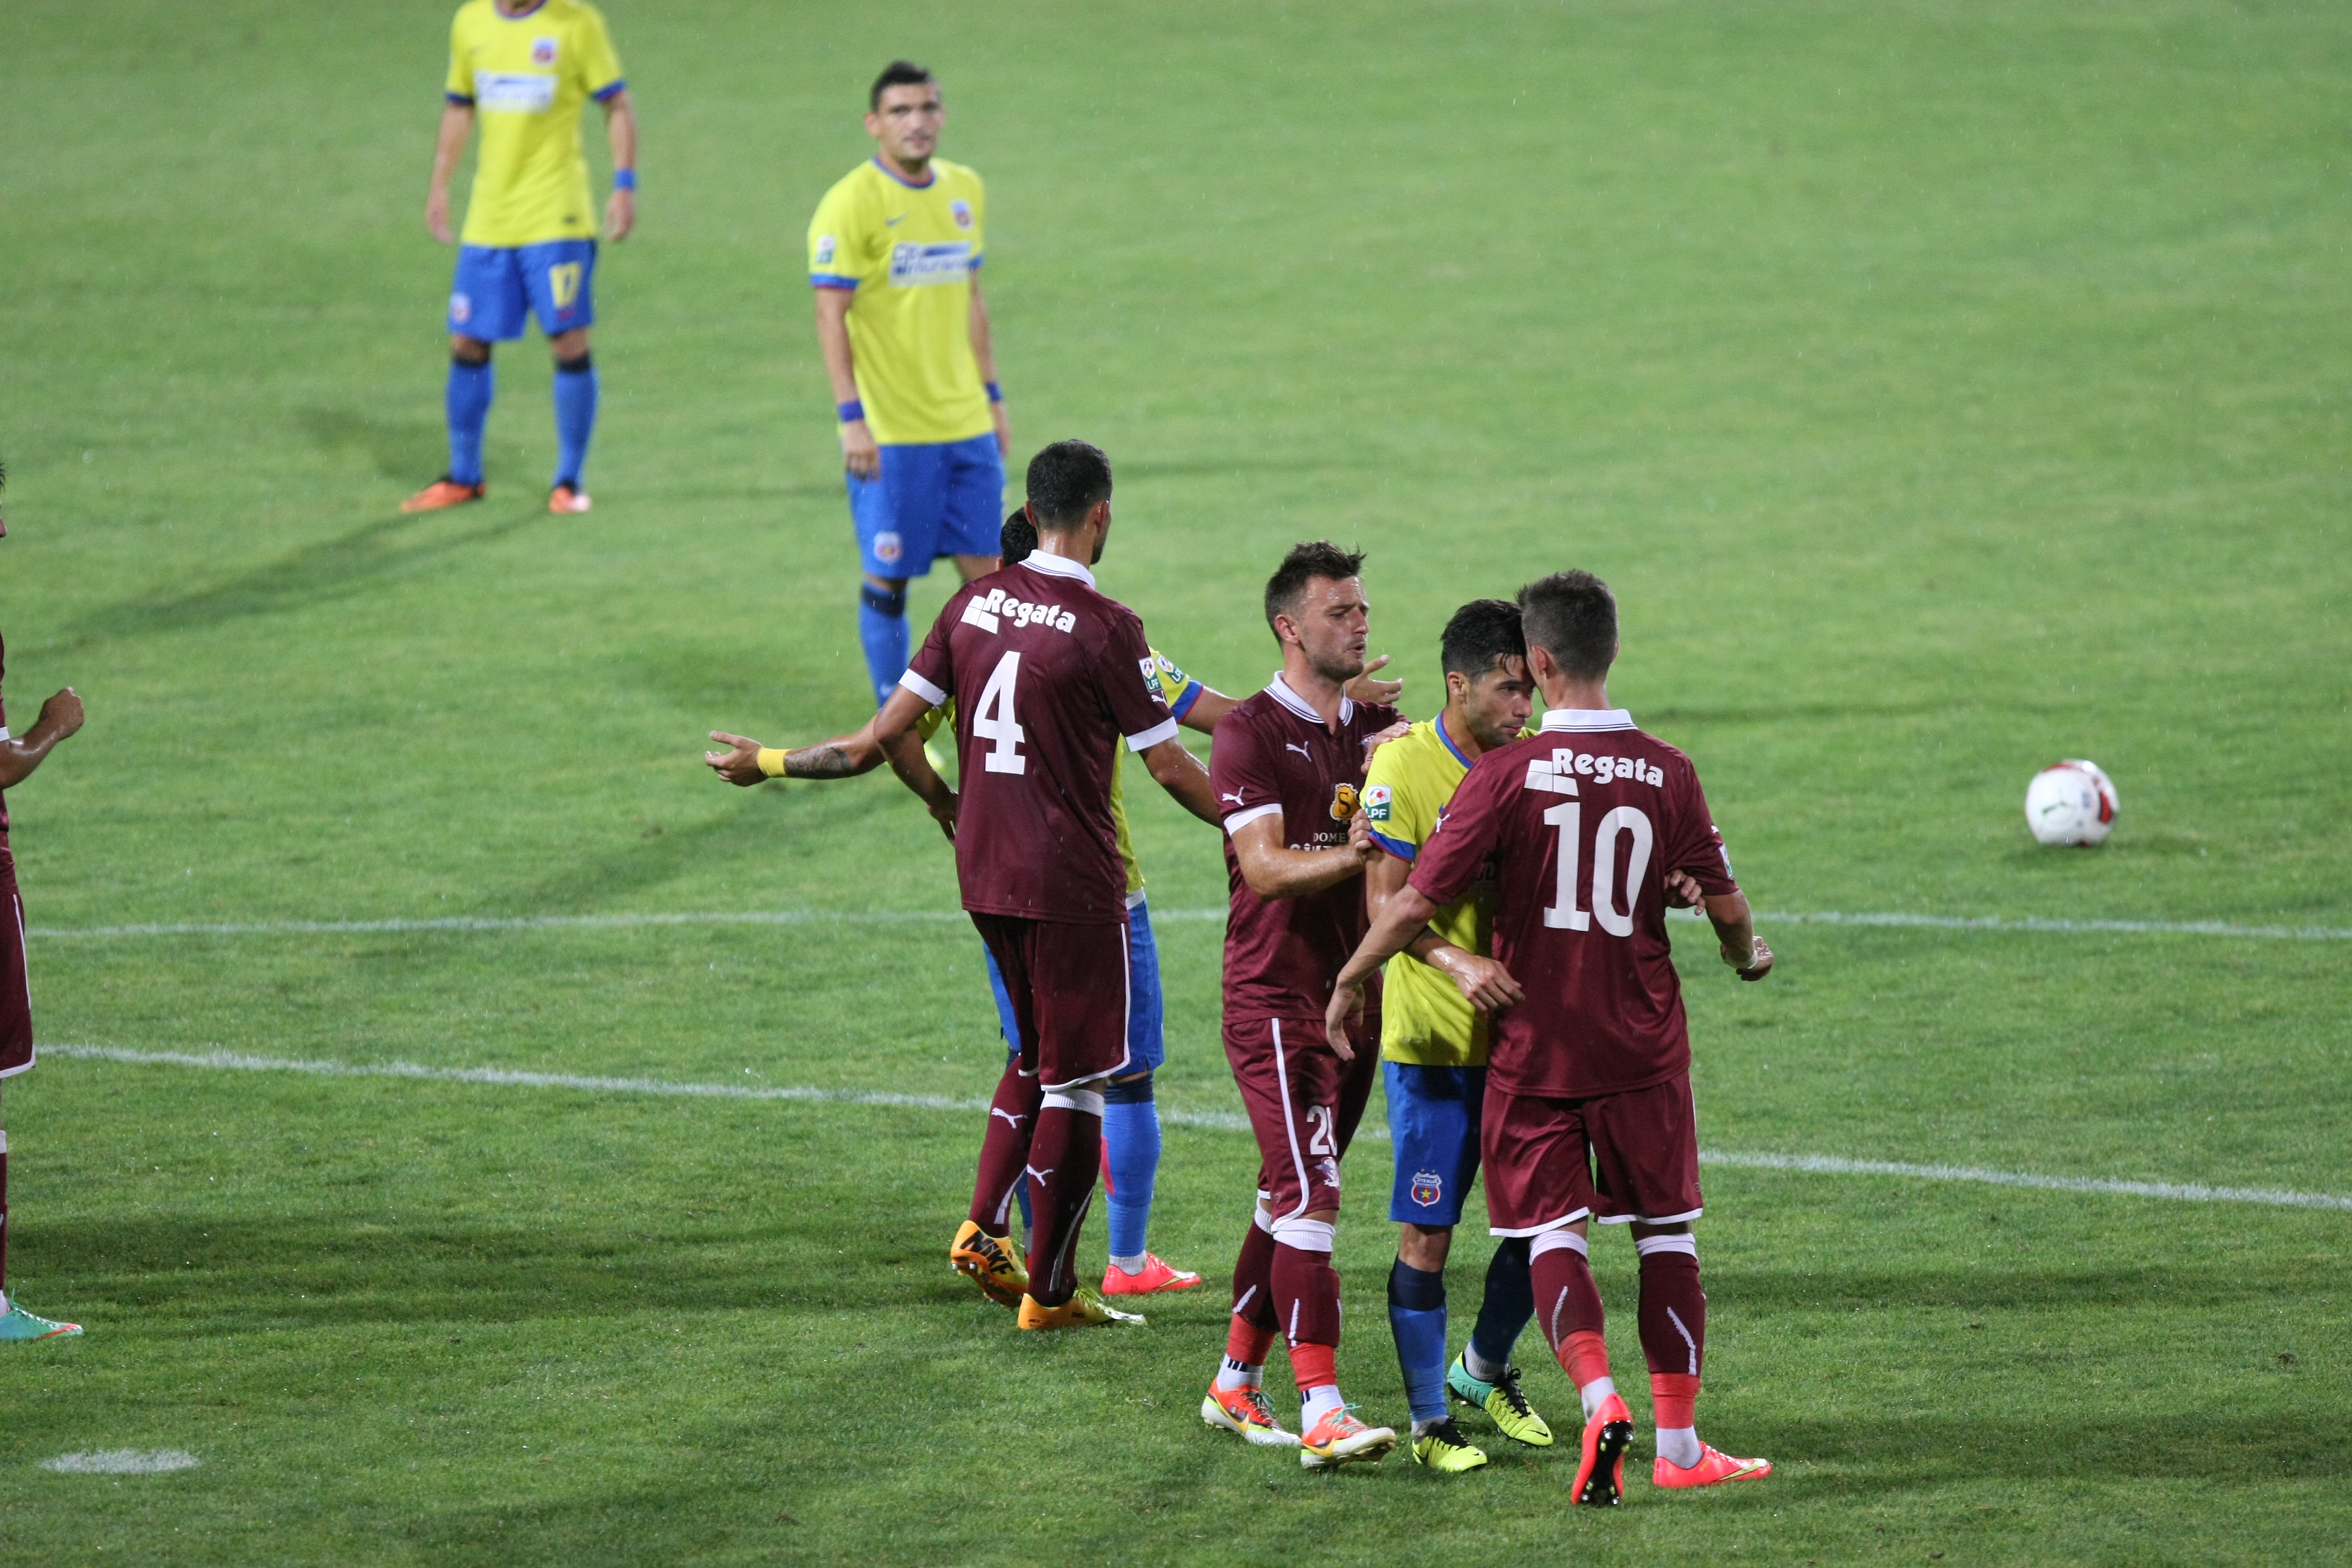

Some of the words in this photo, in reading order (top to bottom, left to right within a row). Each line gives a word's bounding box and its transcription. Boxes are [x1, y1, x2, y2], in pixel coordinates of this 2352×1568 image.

[983, 588, 1076, 633] Regata
[1147, 678, 1158, 690] LPF
[973, 650, 1025, 776] 4
[1552, 748, 1664, 788] Regata
[1312, 832, 1347, 843] DOME
[1543, 802, 1653, 938] 10
